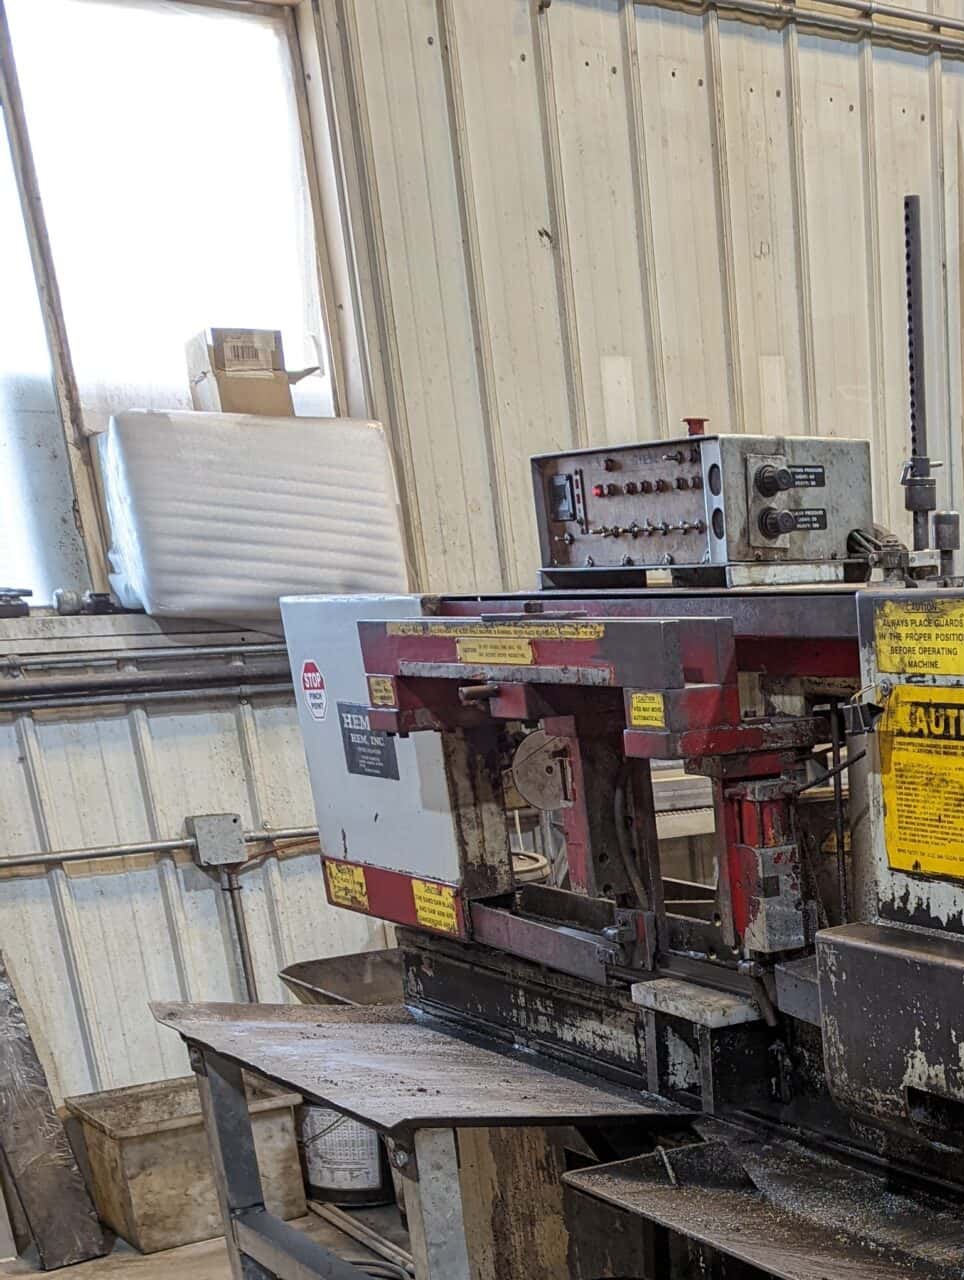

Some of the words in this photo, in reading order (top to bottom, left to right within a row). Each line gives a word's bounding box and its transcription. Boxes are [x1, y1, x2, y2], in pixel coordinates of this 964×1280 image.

[882, 618, 909, 628] ALWAYS
[910, 618, 933, 627] PLACE
[934, 618, 964, 628] GUARDS
[878, 632, 886, 641] IN
[889, 633, 902, 641] THE
[905, 632, 932, 641] PROPER
[890, 646, 916, 655] BEFORE
[918, 646, 958, 656] OPERATING
[303, 672, 322, 689] STOP
[341, 712, 371, 731] HEM
